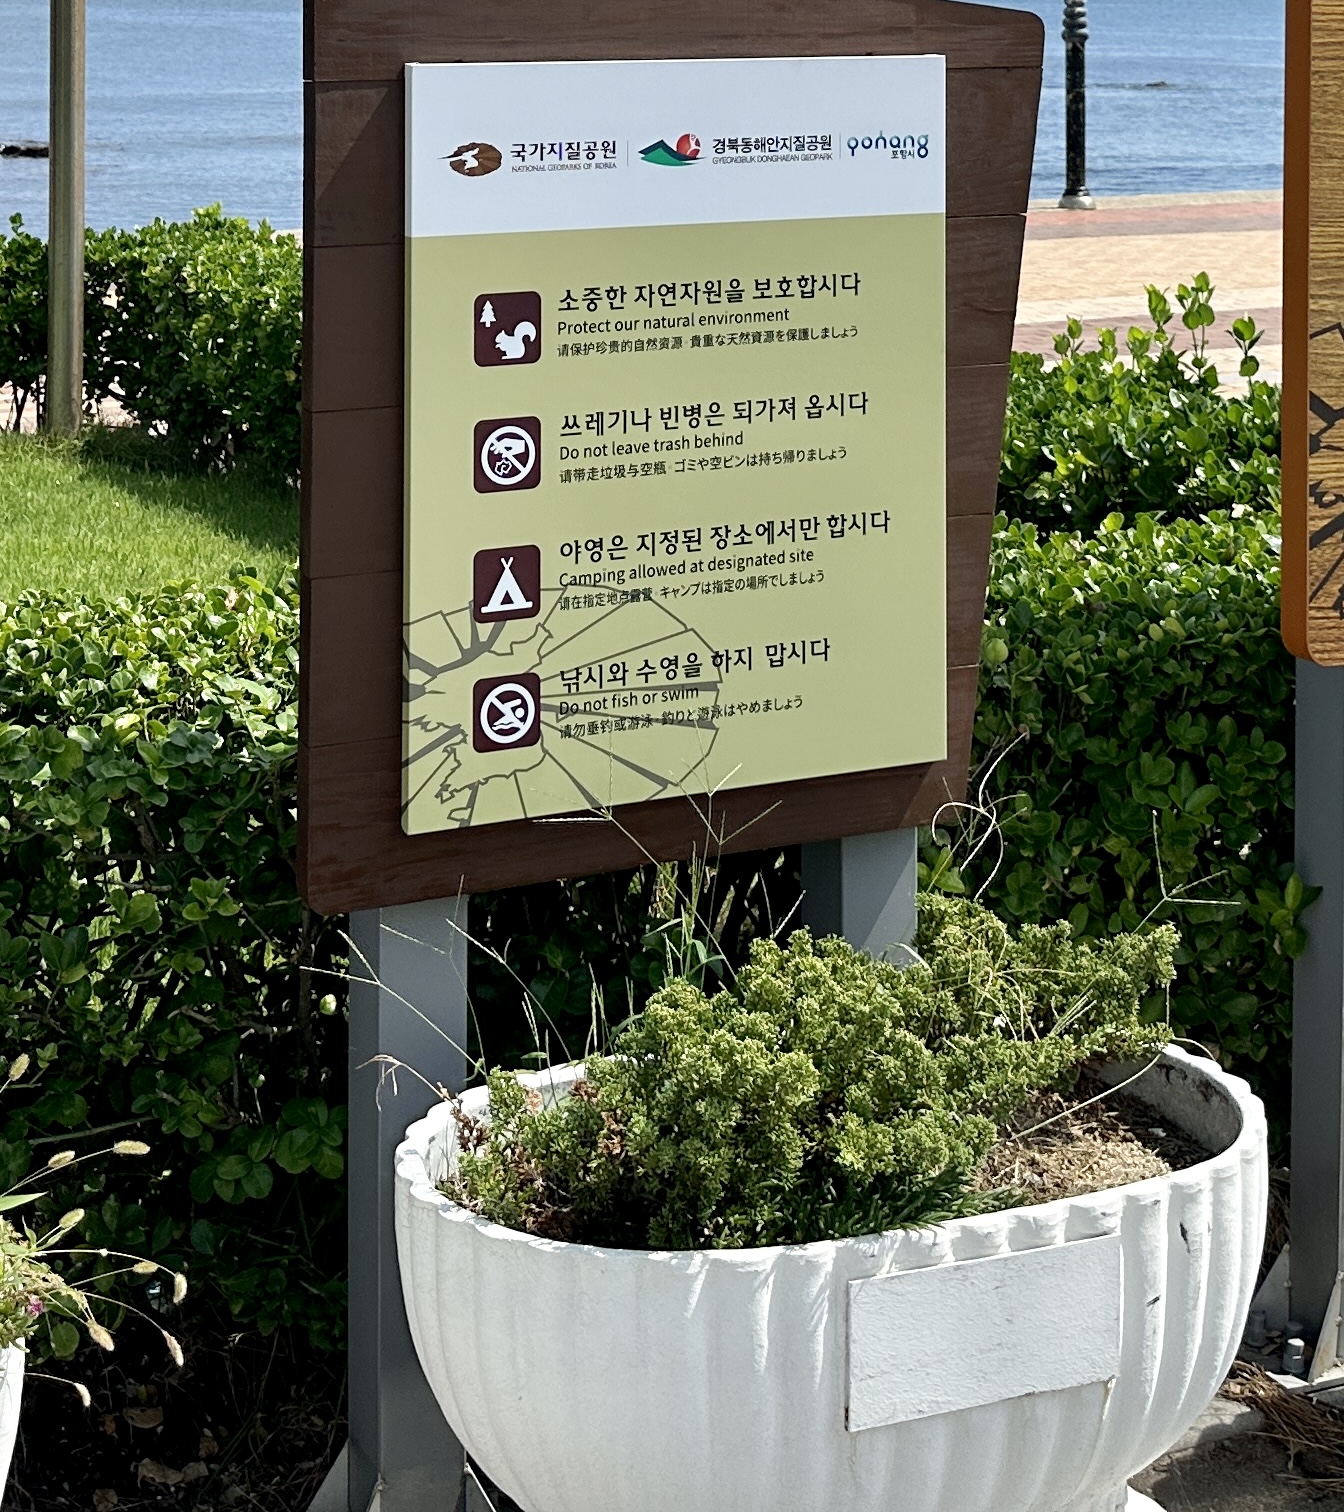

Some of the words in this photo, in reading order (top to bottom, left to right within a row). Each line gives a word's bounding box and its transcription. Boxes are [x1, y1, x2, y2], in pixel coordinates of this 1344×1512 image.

[510, 140, 617, 162] 국가지질공원
[712, 134, 832, 154] 경북동해안지질공원
[558, 285, 627, 312] 소중한
[633, 278, 745, 308] 자연자원을
[752, 272, 862, 300] 보호합시다
[557, 319, 611, 335] Protect
[614, 318, 639, 332] our
[643, 312, 695, 330] natural
[698, 308, 790, 327] environment
[560, 408, 652, 436] 쓰레기나
[659, 401, 725, 430] 빈병은
[732, 396, 797, 424] 되가져
[805, 391, 869, 419] 옵시다
[560, 445, 580, 460] Do
[583, 442, 608, 458] not
[612, 438, 650, 456] leave
[654, 435, 690, 452] trash
[694, 430, 744, 449] behind
[560, 535, 628, 565] 야영은
[636, 527, 702, 557] 지정된
[709, 516, 821, 550] 장소에서만
[826, 510, 891, 538] 합시다
[559, 568, 625, 587] Camping
[629, 561, 686, 580] allowed
[689, 558, 704, 574] at
[707, 550, 786, 573] designated
[789, 548, 814, 563] site
[559, 661, 629, 693] 낚시와
[636, 652, 703, 683] 수영을
[711, 646, 753, 673] 하지
[765, 638, 831, 668] 맙시다
[559, 701, 578, 716] Do
[583, 697, 608, 712] not
[612, 691, 638, 709] fish
[642, 691, 658, 705] or
[661, 687, 699, 702] swim
